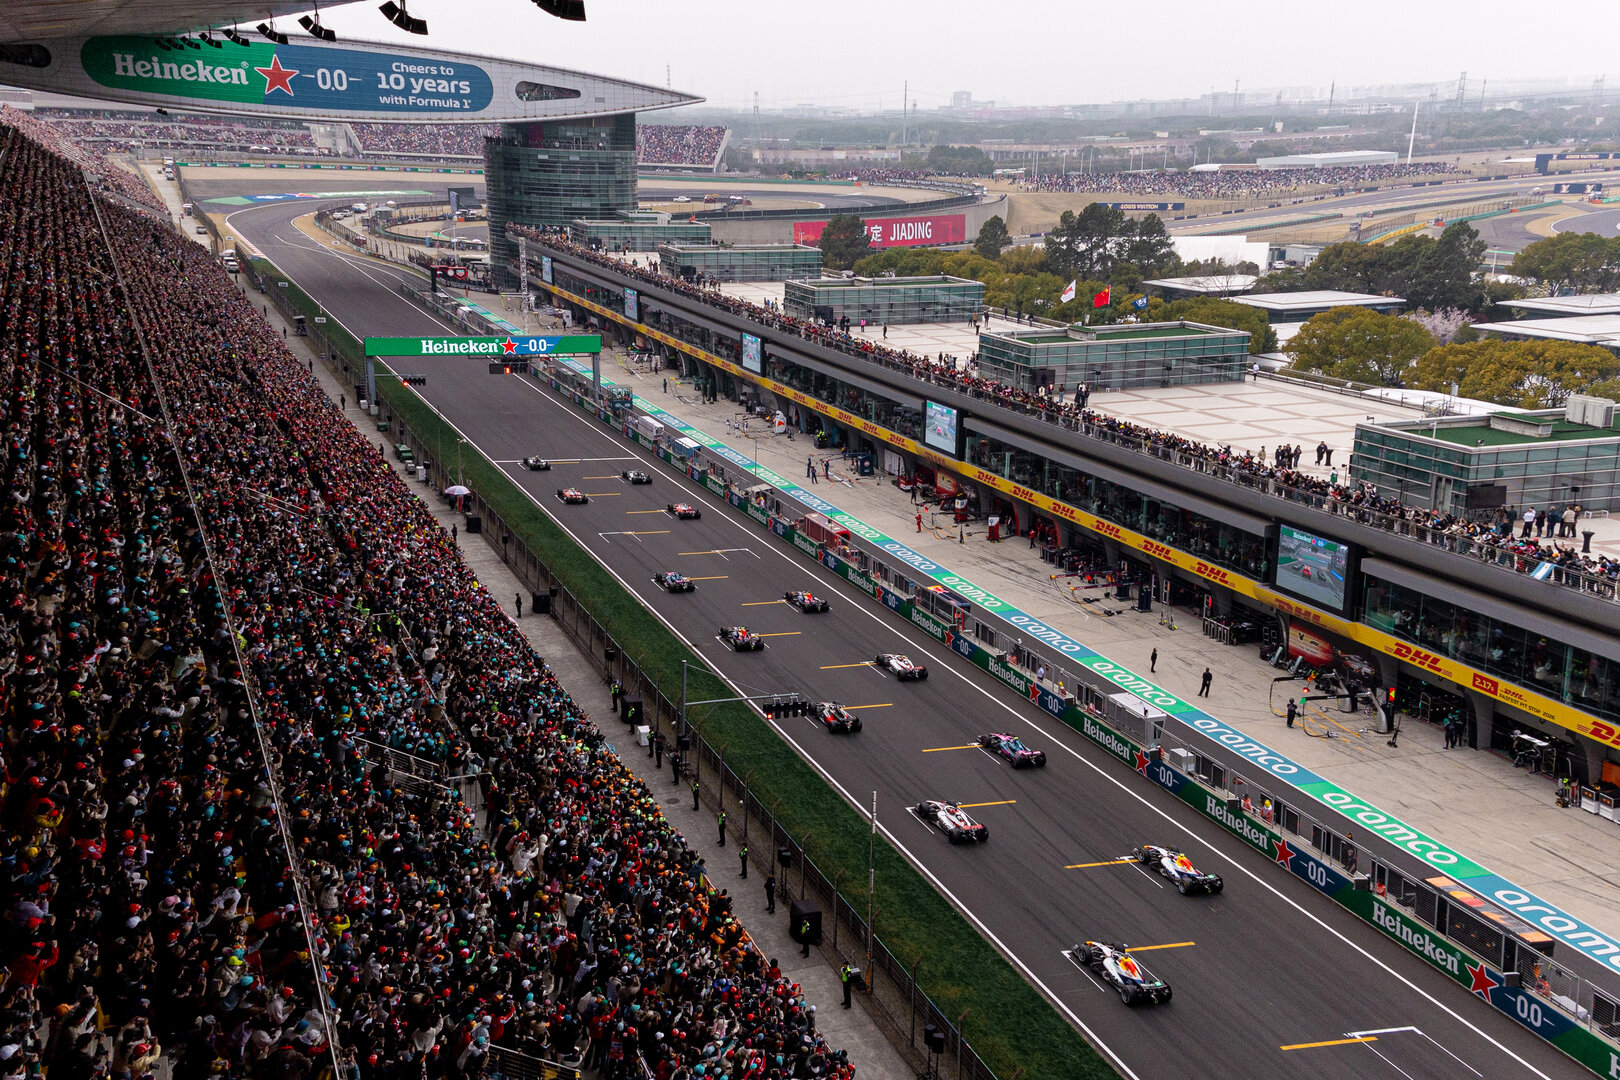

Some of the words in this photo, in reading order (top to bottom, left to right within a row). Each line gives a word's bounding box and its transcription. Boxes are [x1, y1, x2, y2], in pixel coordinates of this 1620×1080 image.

[112, 53, 248, 85] Heineken
[392, 62, 438, 75] Cheers
[440, 66, 454, 76] to
[377, 72, 405, 90] 10
[409, 77, 471, 94] years
[379, 95, 407, 105] with
[408, 96, 460, 109] Formula
[889, 221, 932, 242] JIADING
[421, 339, 499, 354] Heineken
[815, 401, 829, 413] DHL
[838, 411, 853, 423] DHL
[863, 422, 878, 435] DHL
[890, 433, 906, 448] DHL
[976, 470, 998, 487] DHL
[790, 489, 832, 511] aramco
[1013, 485, 1036, 504] DHL
[1051, 501, 1077, 521] DHL
[834, 514, 880, 539] aramco
[1095, 519, 1123, 540] DHL
[793, 533, 817, 556] Heineken
[1143, 539, 1173, 562] DHL
[884, 543, 937, 570] aramco
[847, 567, 874, 593] Heineken
[1196, 561, 1230, 585] DHL
[942, 576, 1002, 607] aramco
[911, 608, 942, 638] Heineken
[1275, 598, 1329, 628] DHL
[1010, 615, 1081, 652] aramco
[1393, 642, 1445, 673] DHL
[988, 656, 1026, 692] Heineken
[1092, 662, 1178, 706] aramco
[1499, 693, 1519, 705] FASTEST
[1528, 705, 1541, 713] STOP
[1503, 688, 1525, 701] DHL
[1083, 716, 1131, 761] Heineken
[1193, 719, 1299, 774] aramco
[1206, 795, 1269, 850] Heineken
[1322, 792, 1459, 864] aramco
[1372, 900, 1461, 975] Heineken
